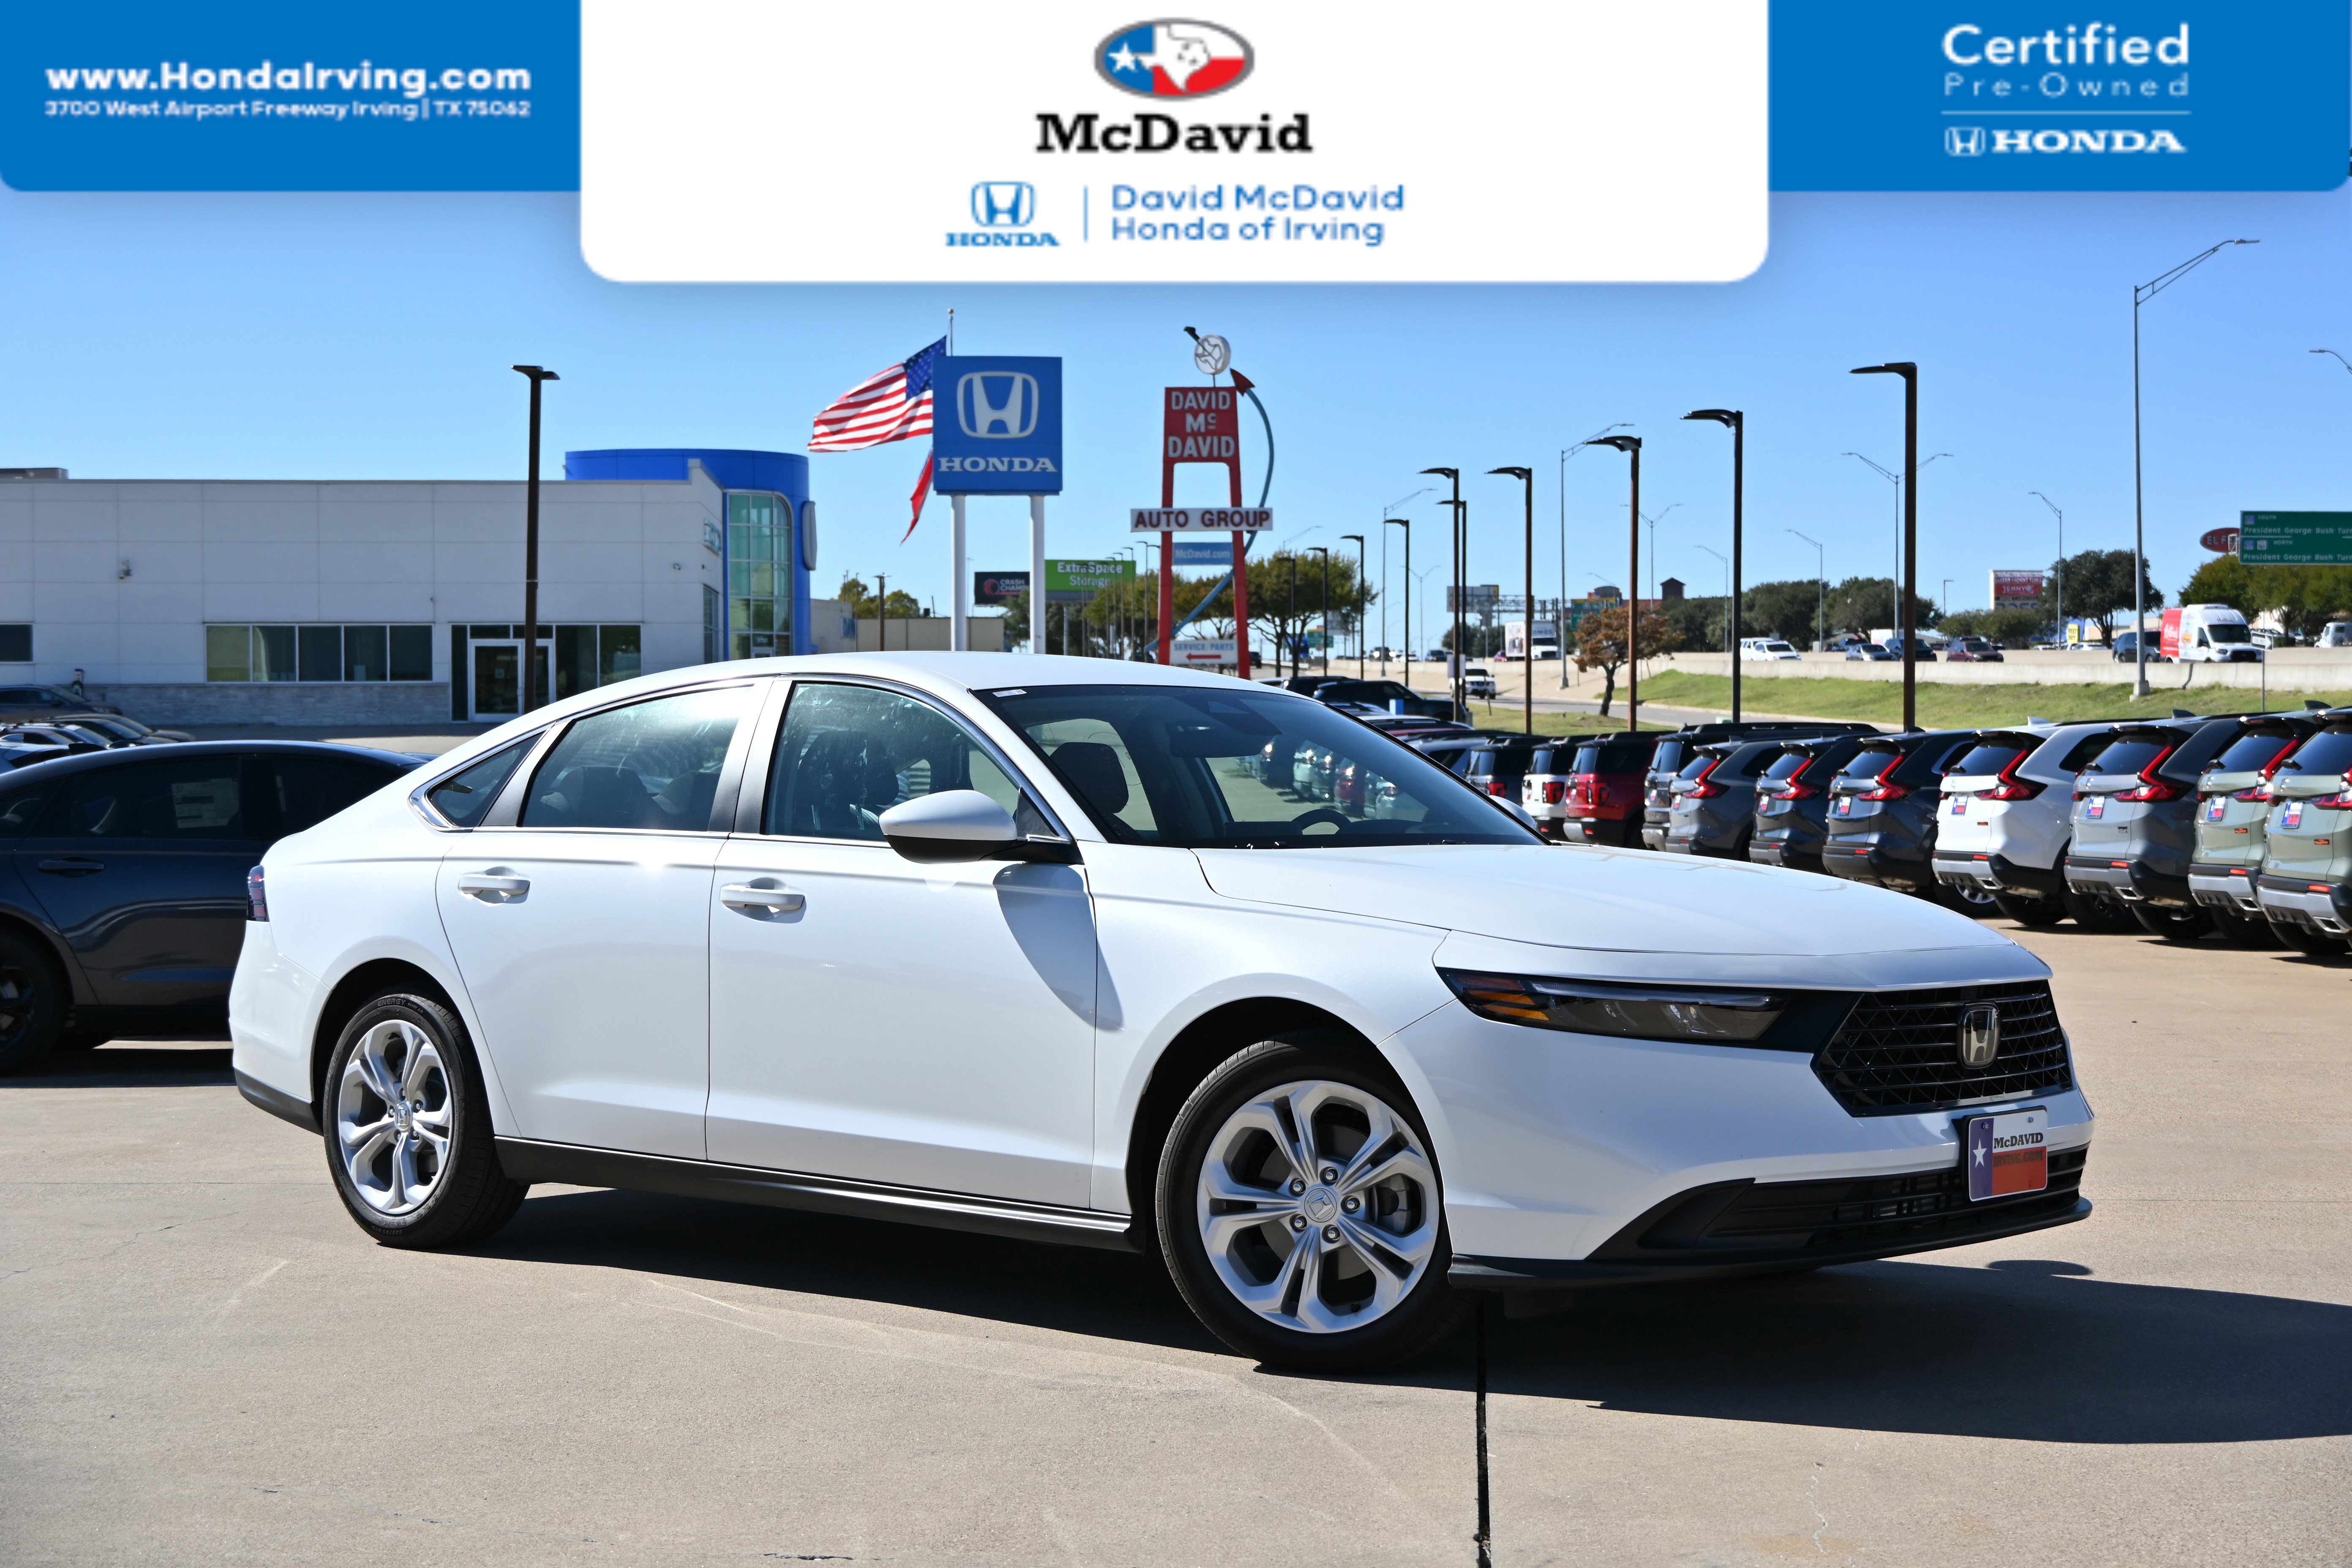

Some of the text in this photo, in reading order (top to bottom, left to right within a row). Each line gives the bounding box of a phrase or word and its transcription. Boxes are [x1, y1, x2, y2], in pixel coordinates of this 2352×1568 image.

[1171, 391, 1231, 410] DAVID
[1168, 436, 1235, 458] DAVID
[938, 457, 1057, 472] HONDA
[1135, 510, 1269, 528] AUTO GROUP
[1175, 549, 1231, 558] McDavid.com
[378, 998, 406, 1007] ENERGY
[1993, 1132, 2044, 1149] McDAVID
[1993, 1149, 2043, 1167] IRVING.COM
